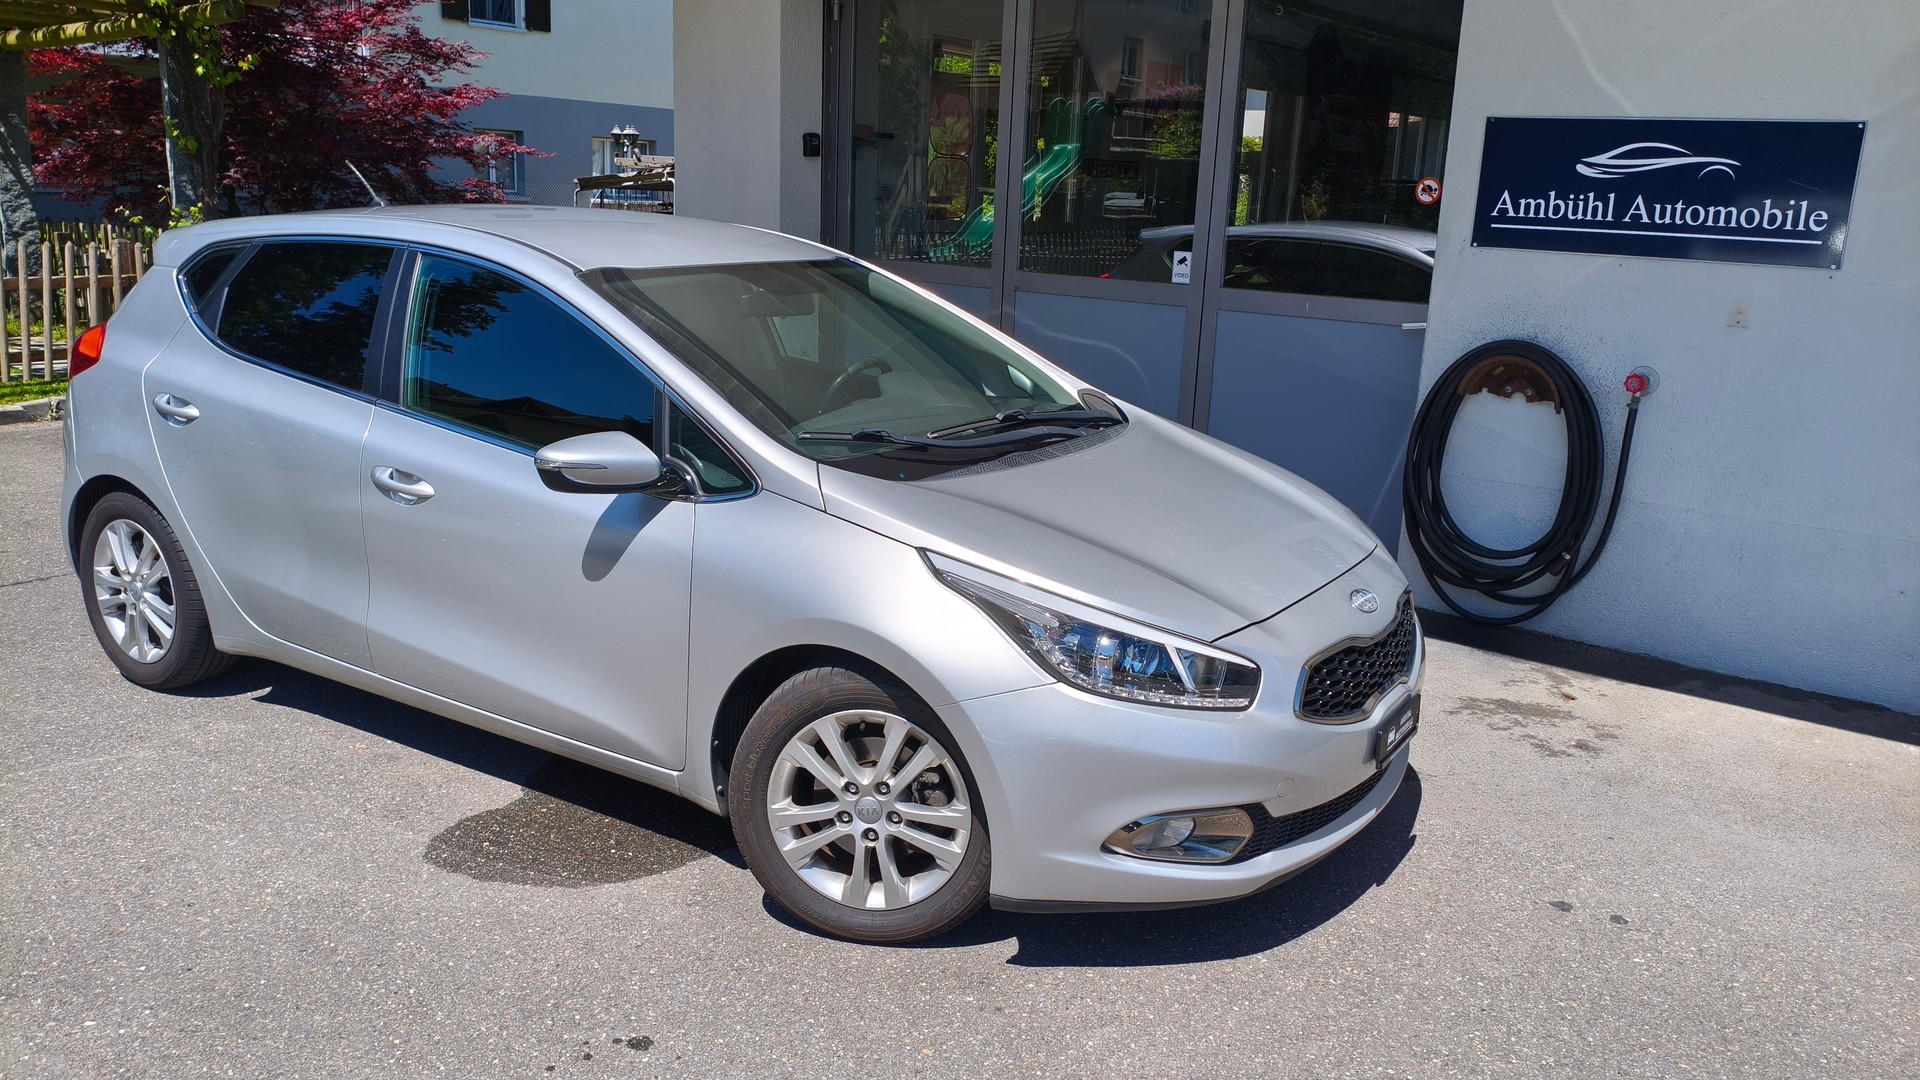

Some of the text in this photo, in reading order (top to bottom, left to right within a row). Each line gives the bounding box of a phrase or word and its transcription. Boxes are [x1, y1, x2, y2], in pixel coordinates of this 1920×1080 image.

[1491, 189, 1829, 233] Ambühl Automobile
[856, 806, 881, 817] KIA
